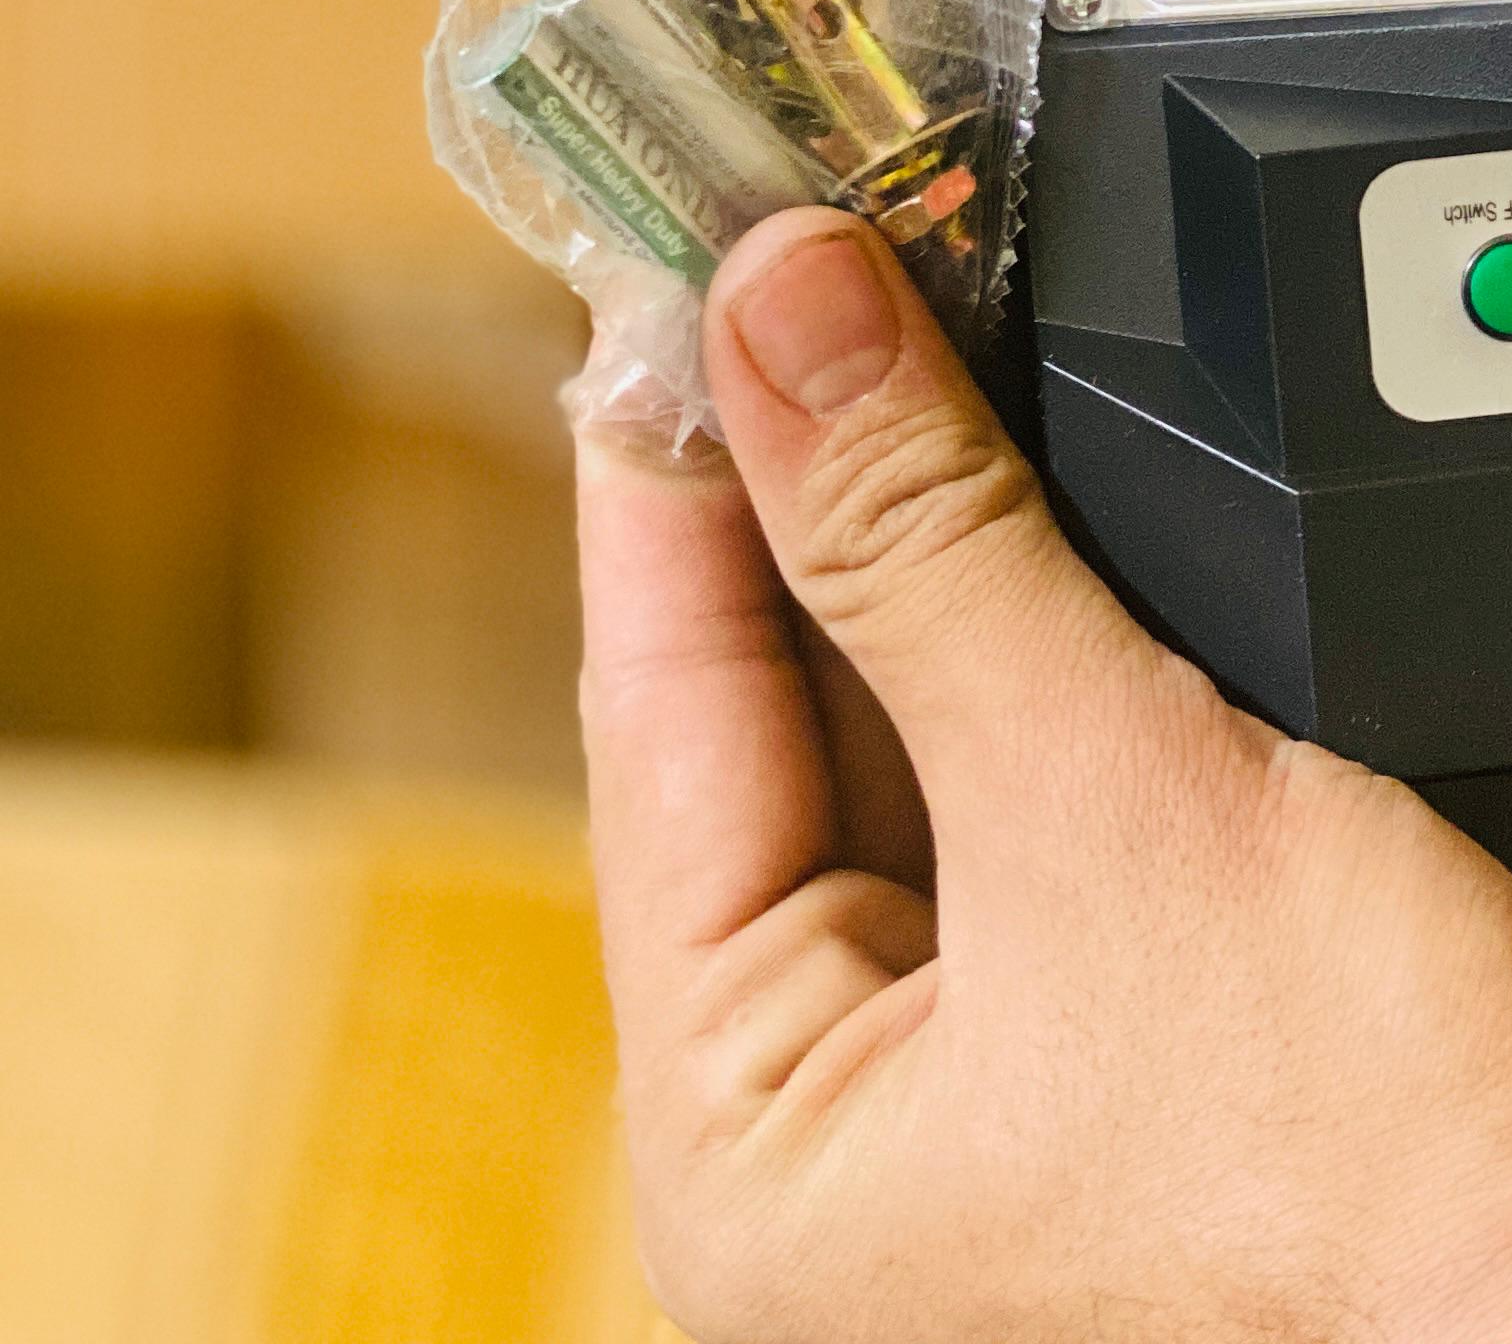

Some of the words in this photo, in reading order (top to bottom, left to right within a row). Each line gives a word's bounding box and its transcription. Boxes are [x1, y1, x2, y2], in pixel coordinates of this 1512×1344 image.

[537, 96, 597, 156] Super
[591, 147, 648, 214] Heavy
[643, 207, 690, 257] Duty
[1443, 200, 1498, 226] Switch
